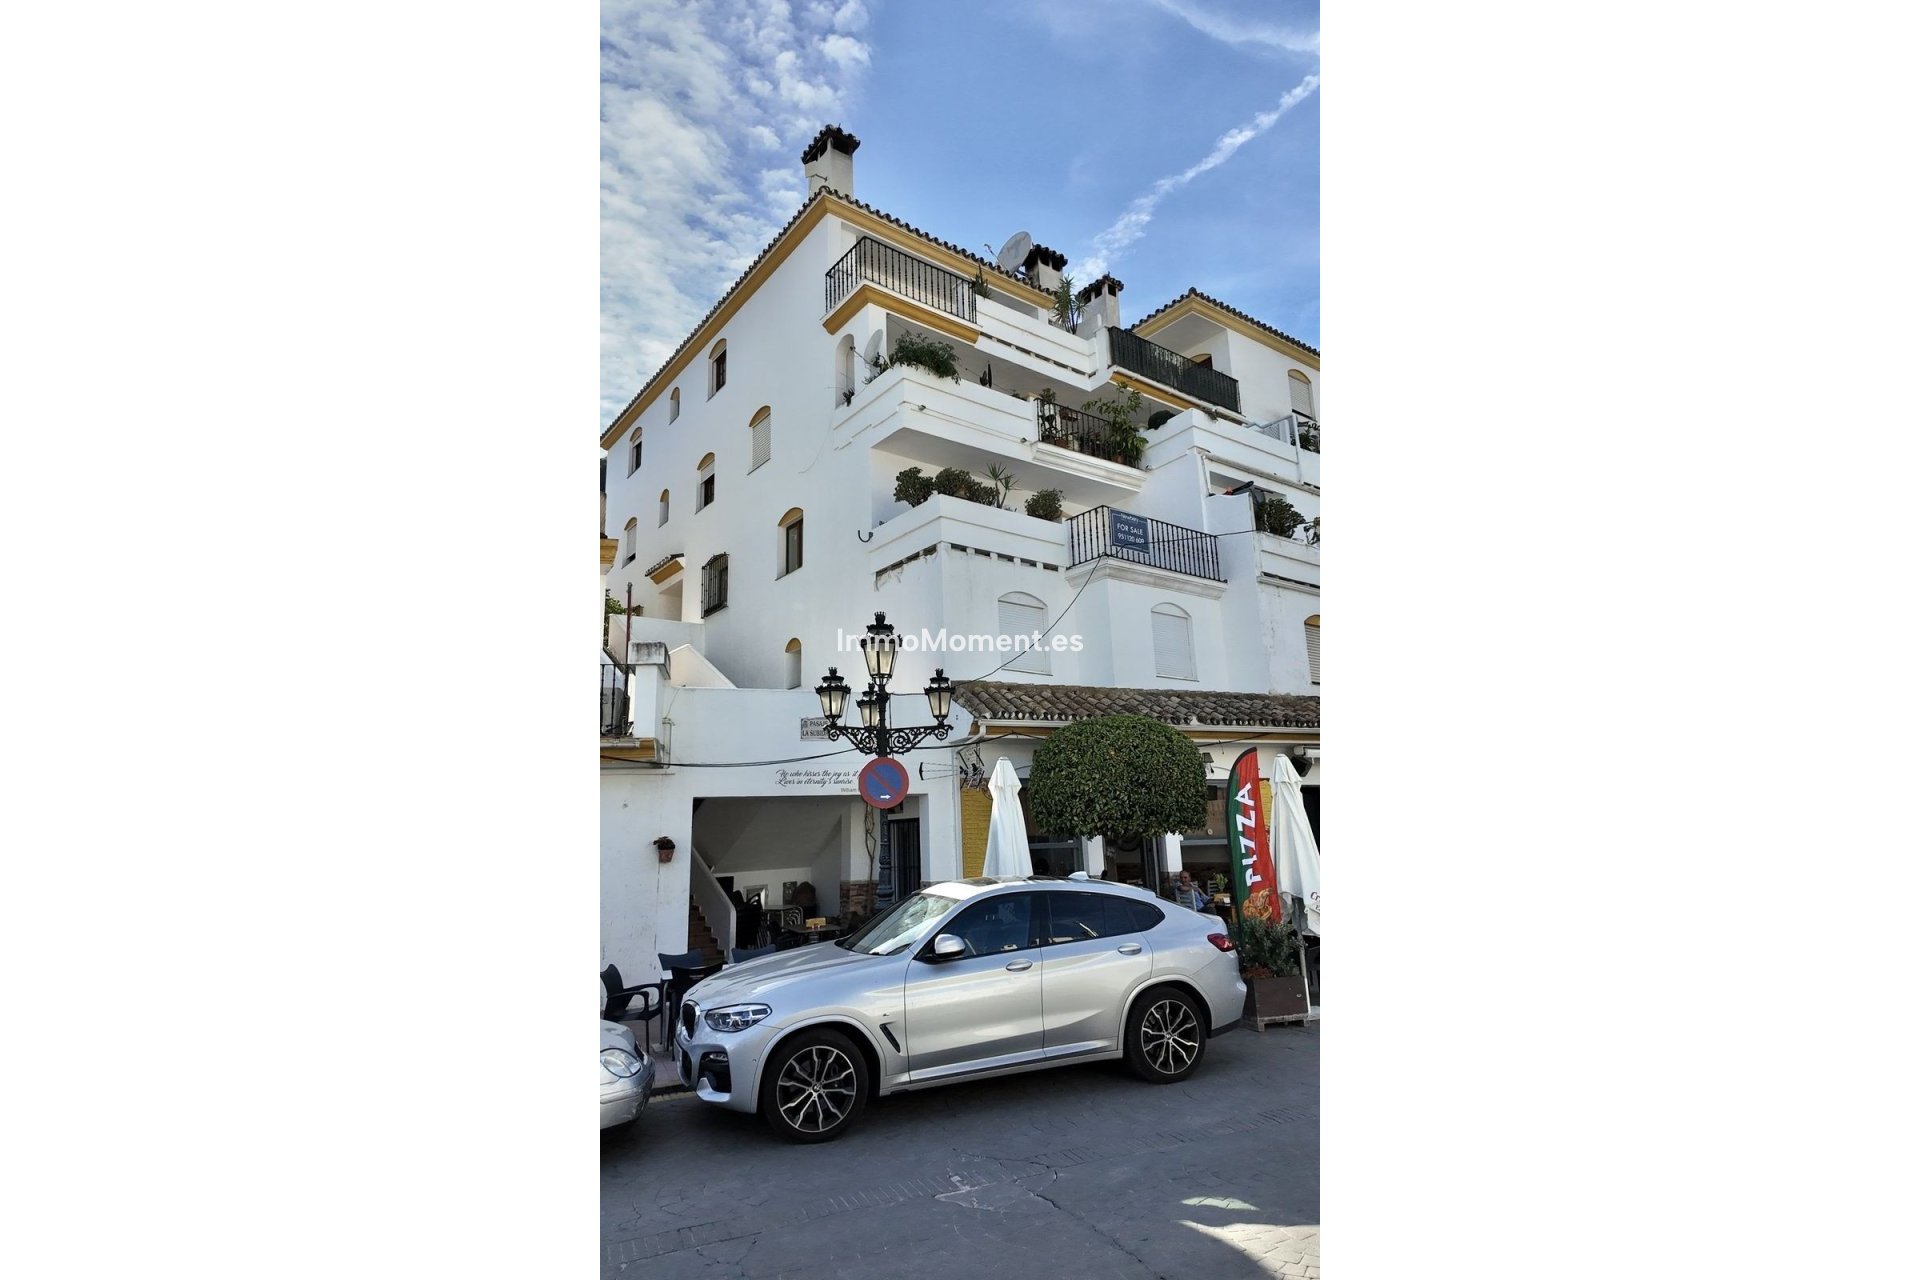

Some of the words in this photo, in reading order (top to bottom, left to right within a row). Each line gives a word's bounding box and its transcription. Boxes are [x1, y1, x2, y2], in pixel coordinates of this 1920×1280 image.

[1117, 523, 1129, 532] FOR
[1130, 526, 1143, 535] SALE
[810, 720, 829, 728] PASAJE
[802, 729, 809, 737] LA
[822, 769, 831, 777] the
[831, 770, 843, 780] joy
[803, 777, 832, 788] eternity's
[1234, 782, 1262, 887] PIZZA
